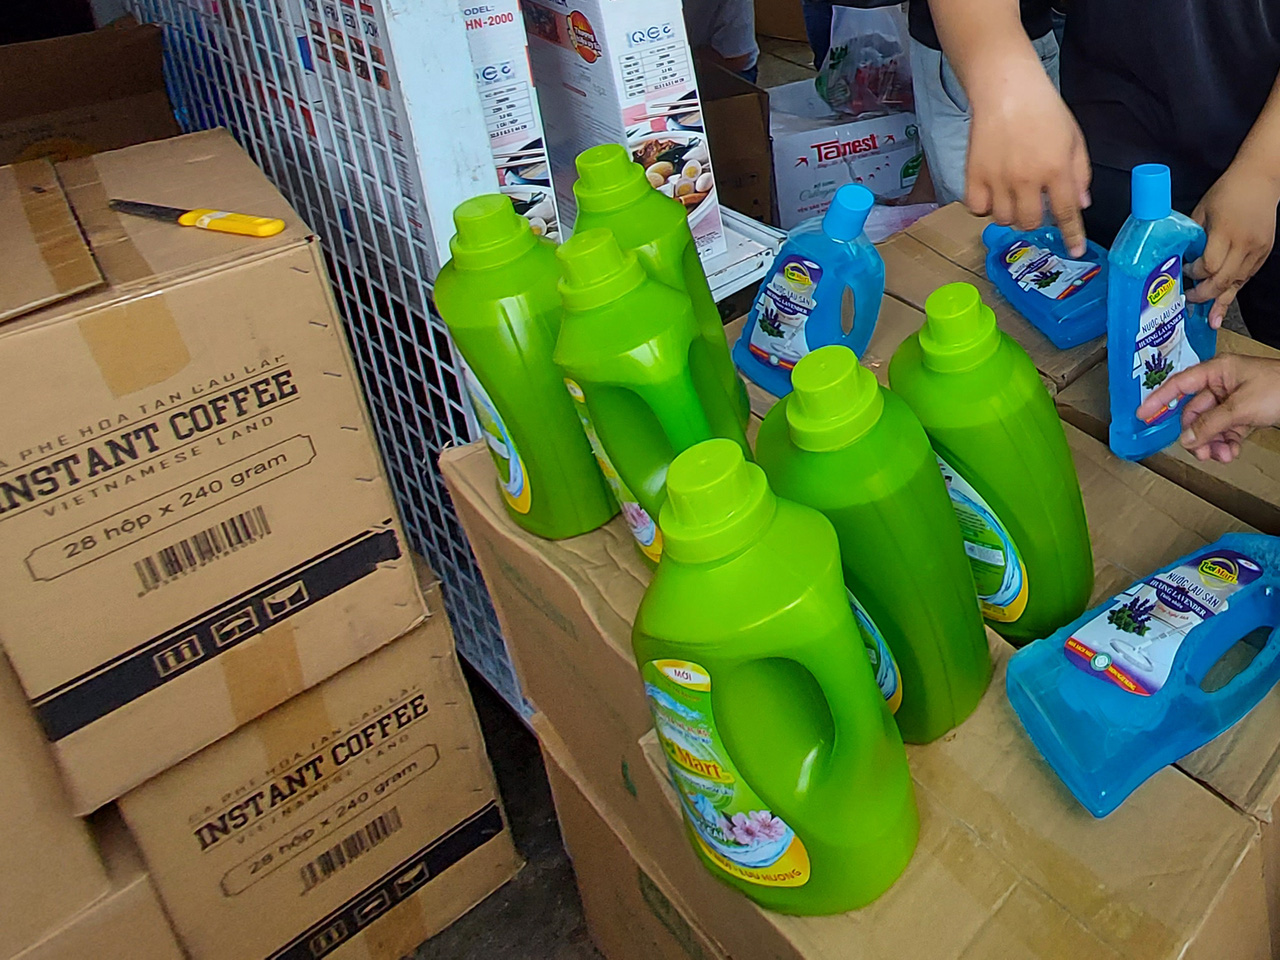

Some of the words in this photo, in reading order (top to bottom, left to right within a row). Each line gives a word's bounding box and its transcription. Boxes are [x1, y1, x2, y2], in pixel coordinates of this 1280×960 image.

[464, 12, 515, 32] HN-2000
[168, 369, 300, 441] COFFEE
[42, 445, 203, 517] VIETNAMESE
[216, 415, 275, 446] LAND
[61, 535, 99, 560] 28
[104, 508, 154, 543] hộp
[158, 504, 176, 518] x
[180, 478, 225, 509] 240
[229, 450, 289, 489] gram
[193, 753, 325, 852] INSTANT
[330, 693, 430, 767] COFFEE
[335, 791, 370, 819] 240
[373, 761, 419, 795] gram
